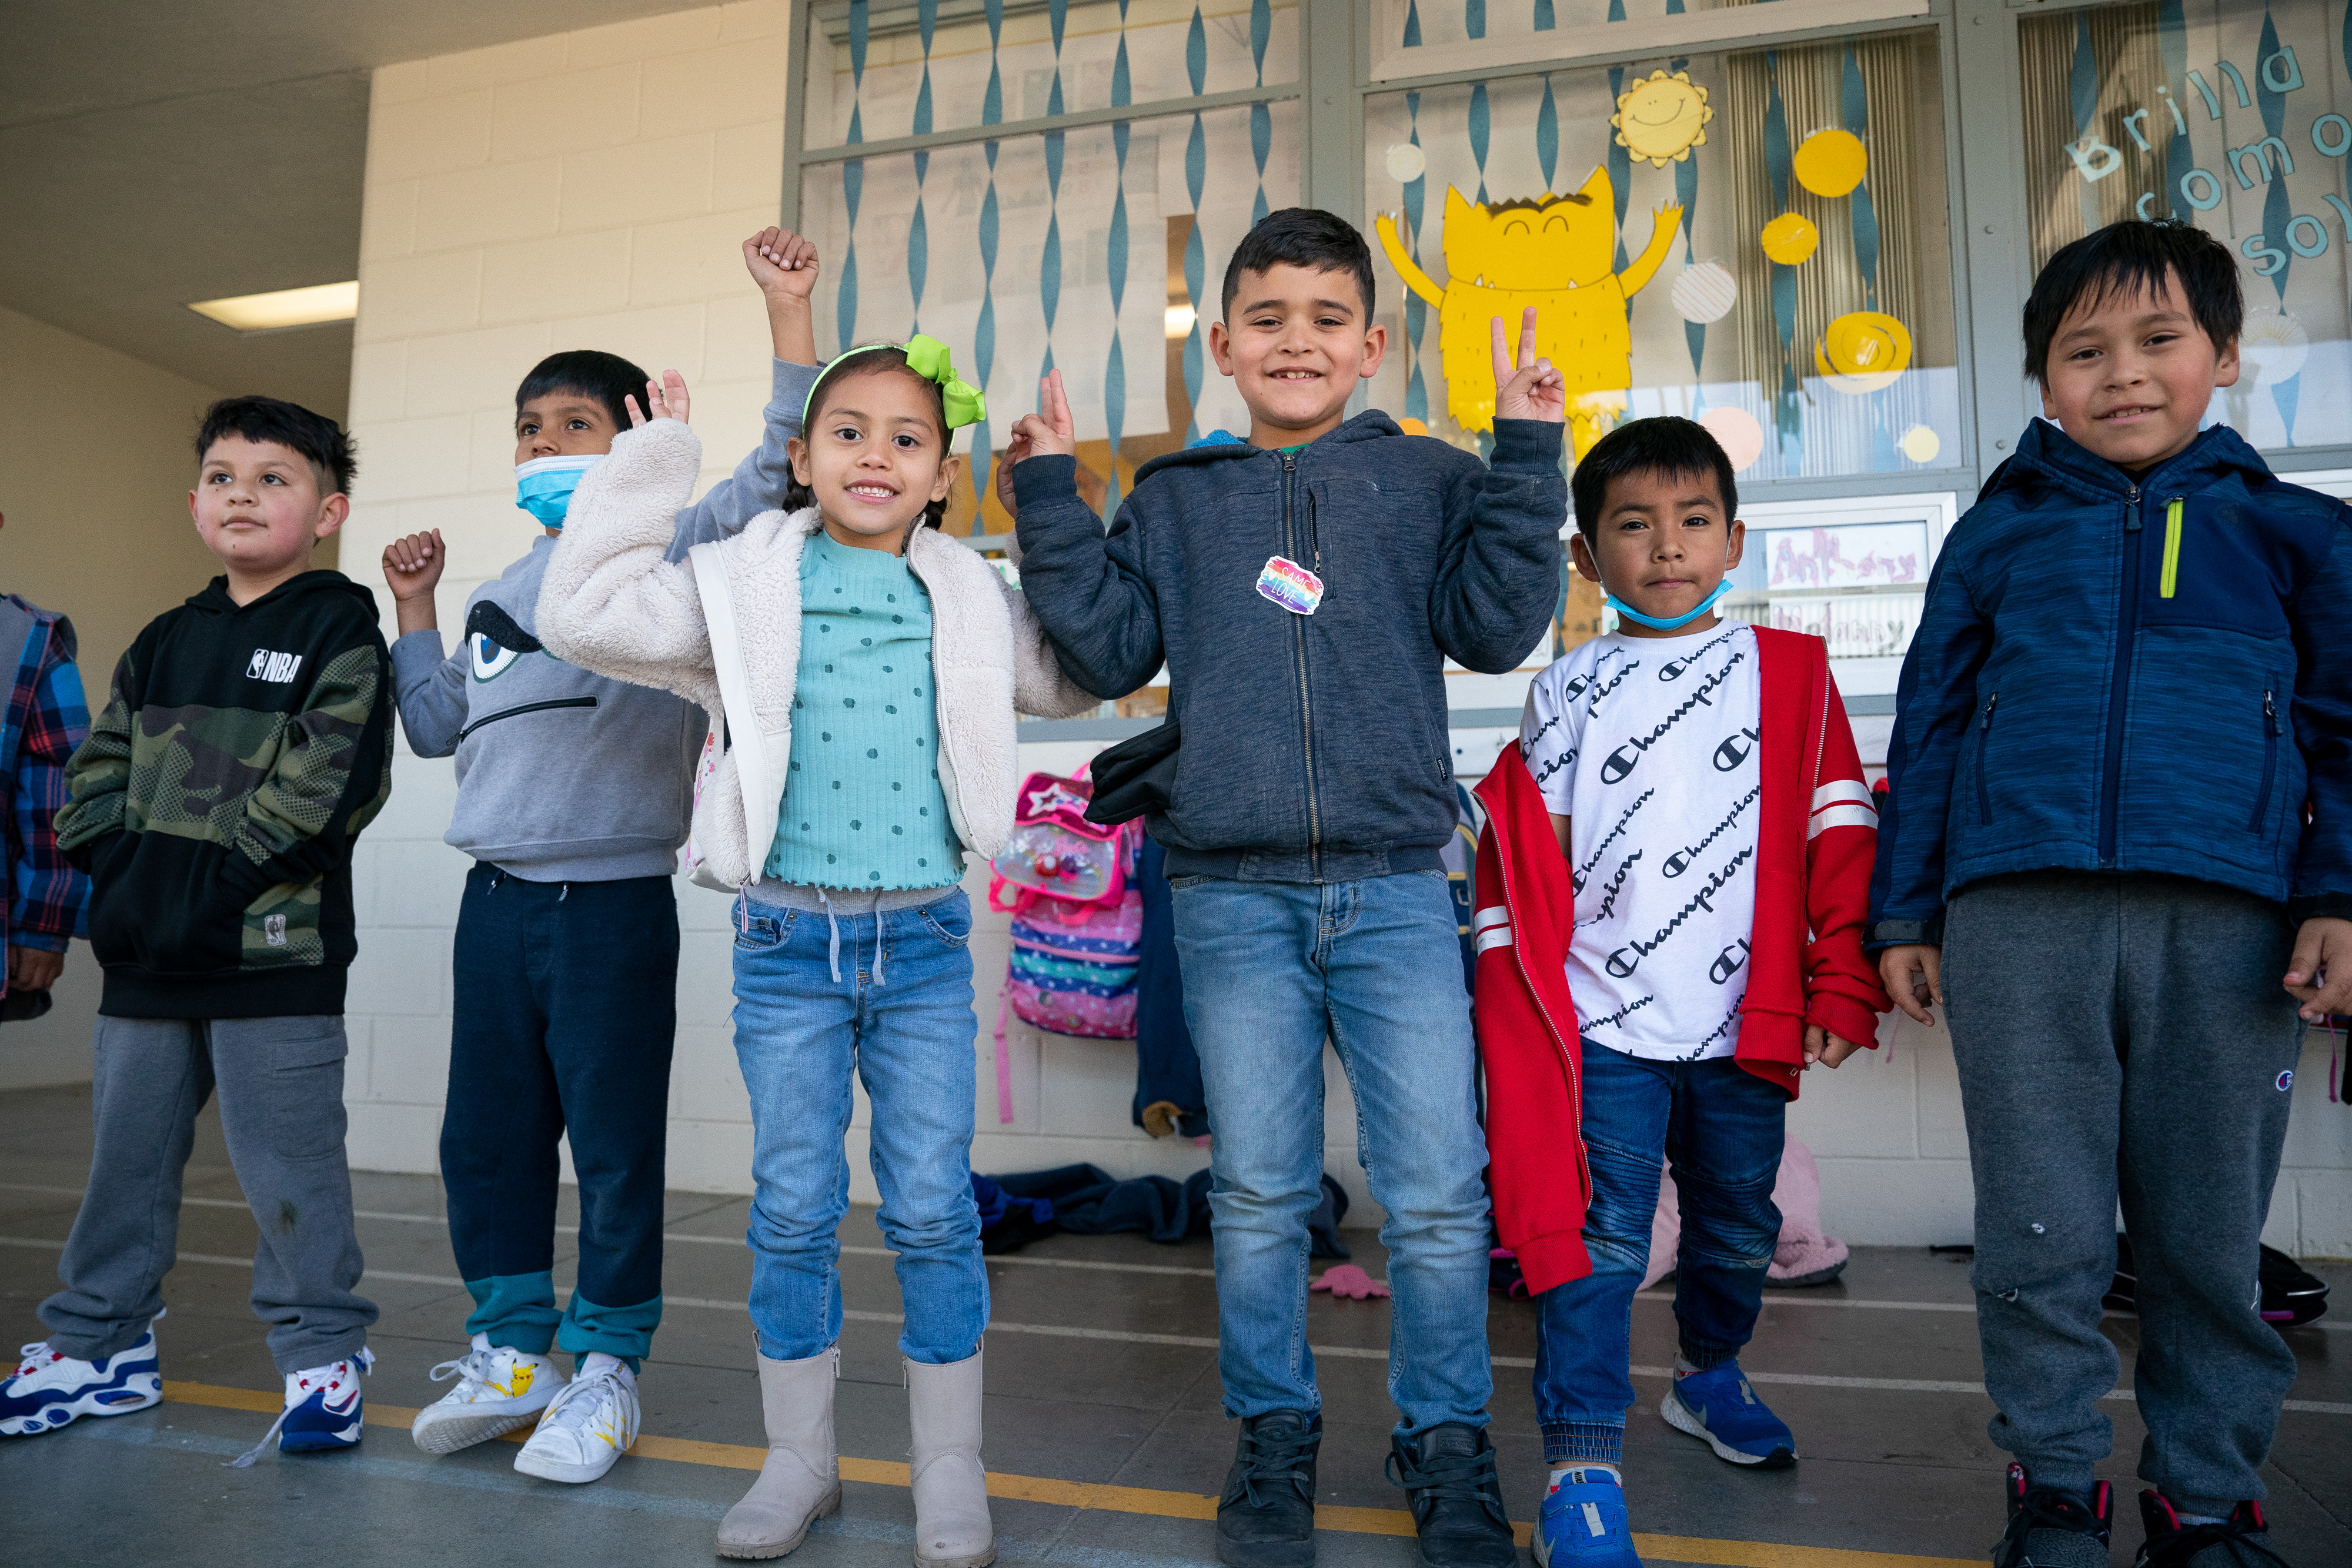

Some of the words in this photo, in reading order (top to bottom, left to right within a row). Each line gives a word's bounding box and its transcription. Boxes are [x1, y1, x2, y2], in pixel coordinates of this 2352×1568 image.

[1271, 581, 1301, 604] LOVE
[1278, 567, 1311, 593] SAME
[261, 651, 303, 683] NBA
[1601, 651, 1745, 785] Champion
[1605, 845, 1753, 978] Champion
